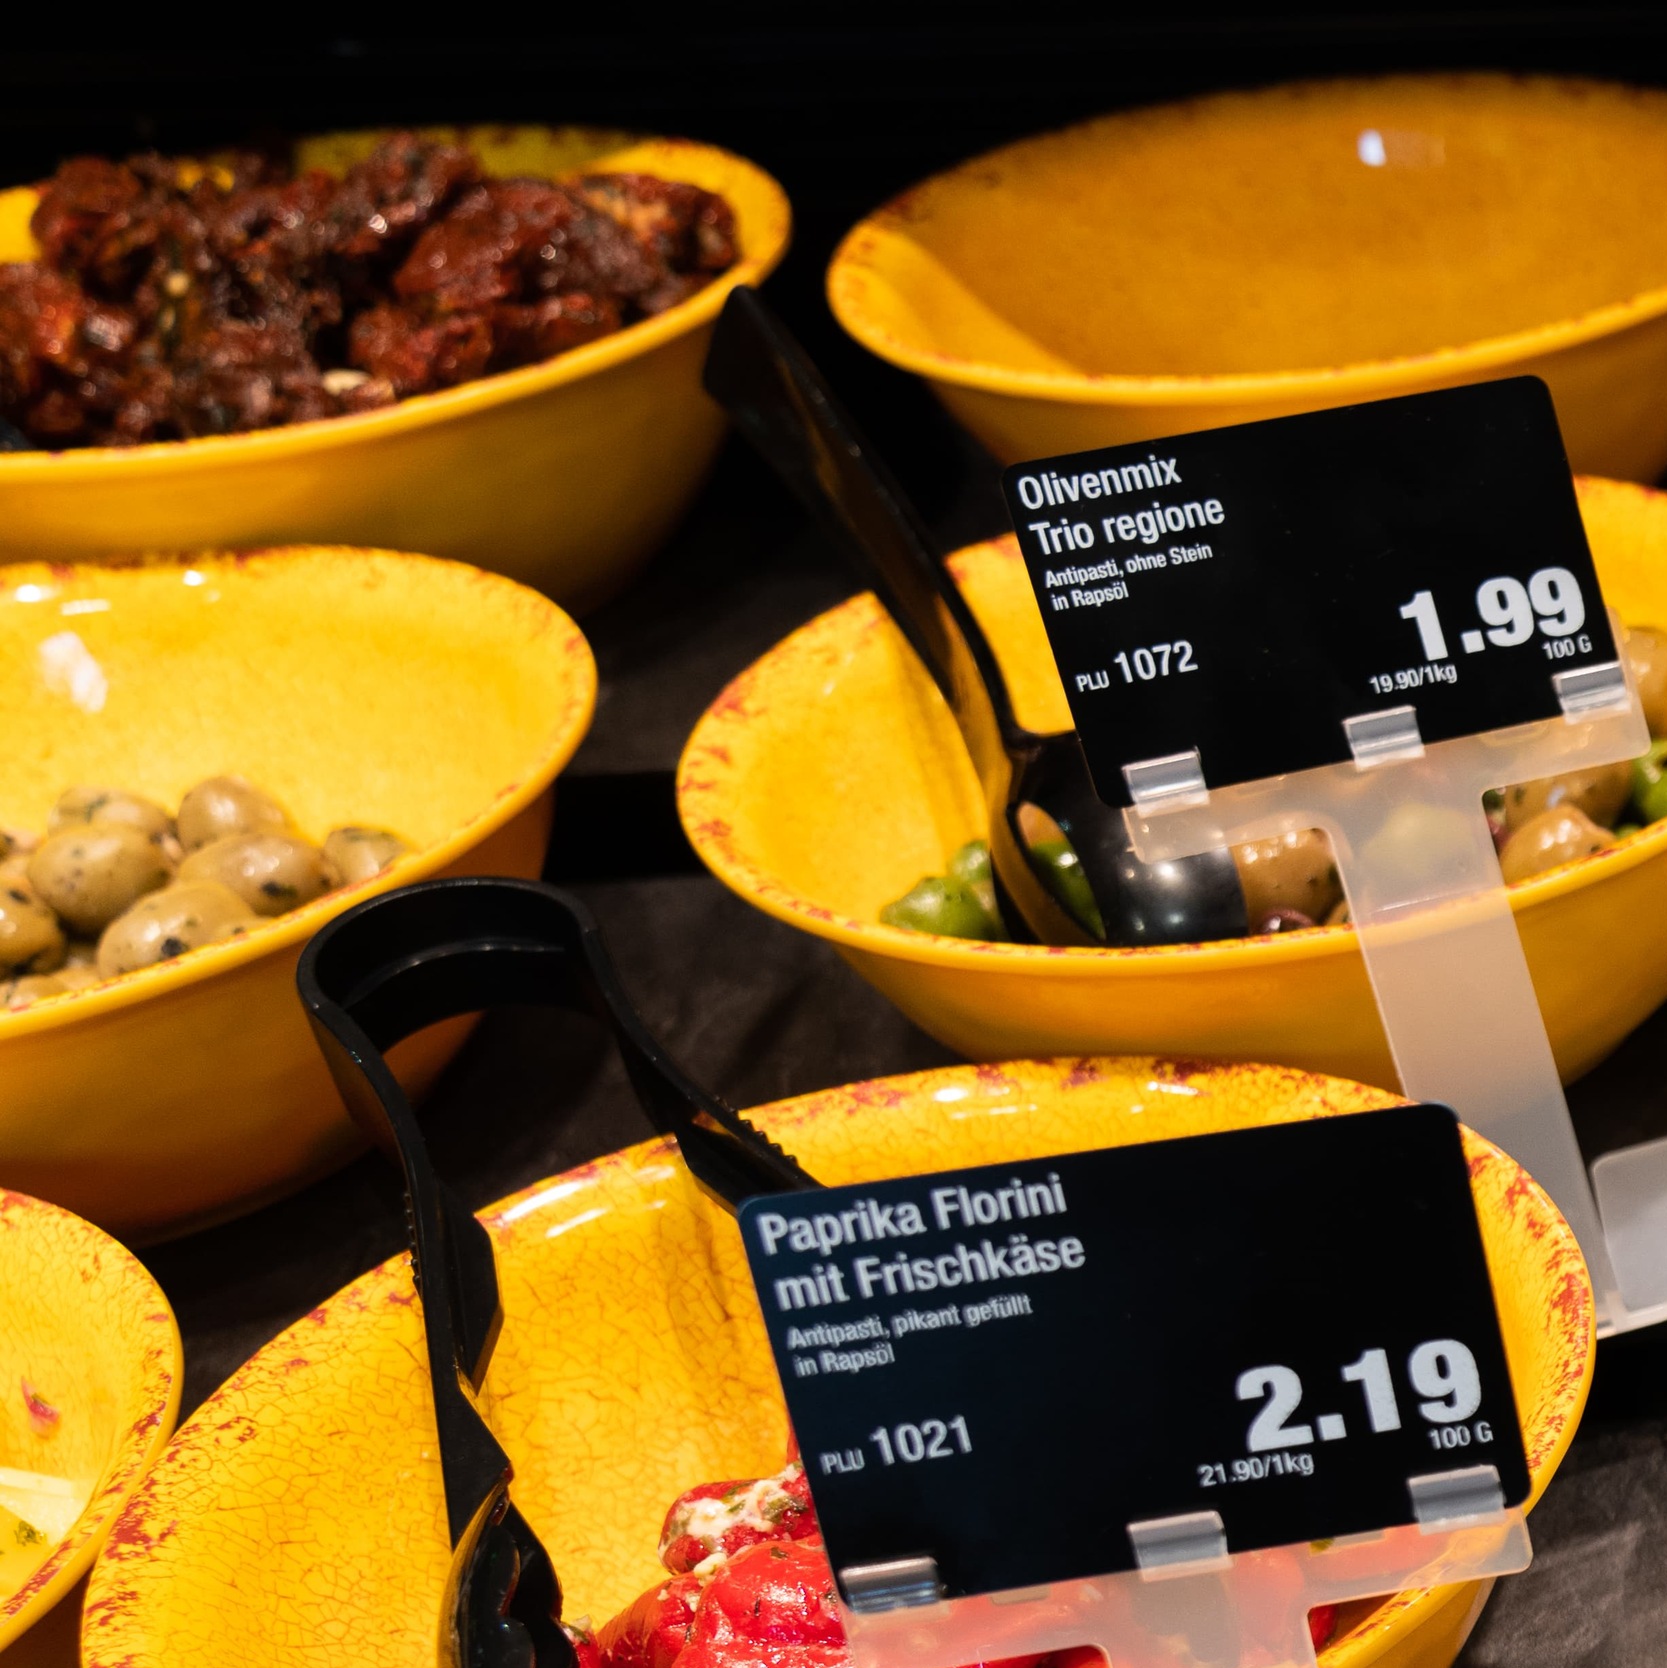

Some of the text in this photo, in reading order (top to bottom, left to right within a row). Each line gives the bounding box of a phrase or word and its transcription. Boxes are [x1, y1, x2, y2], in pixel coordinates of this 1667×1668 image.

[1018, 457, 1182, 509] Olivenmix
[1029, 500, 1224, 554] Trio regione
[1046, 544, 1212, 588] Antipasti, ohne Stein
[1051, 581, 1128, 610] in Rapsöl
[1400, 567, 1586, 661] 1.99
[1076, 641, 1198, 692] PLU 1072
[1543, 638, 1575, 659] 100
[1370, 664, 1457, 693] 19.90/1kg
[757, 1174, 1067, 1255] Paprika Florini
[775, 1235, 1085, 1310] mit Frischkäse
[788, 1295, 1033, 1348] Antipasti, pikant gefüllt
[795, 1343, 895, 1376] in Rapsöl
[1235, 1338, 1482, 1453] 2.19
[821, 1416, 972, 1473] PLU 1021
[1430, 1426, 1470, 1449] 100
[1198, 1453, 1314, 1486] 21.90/1kg
